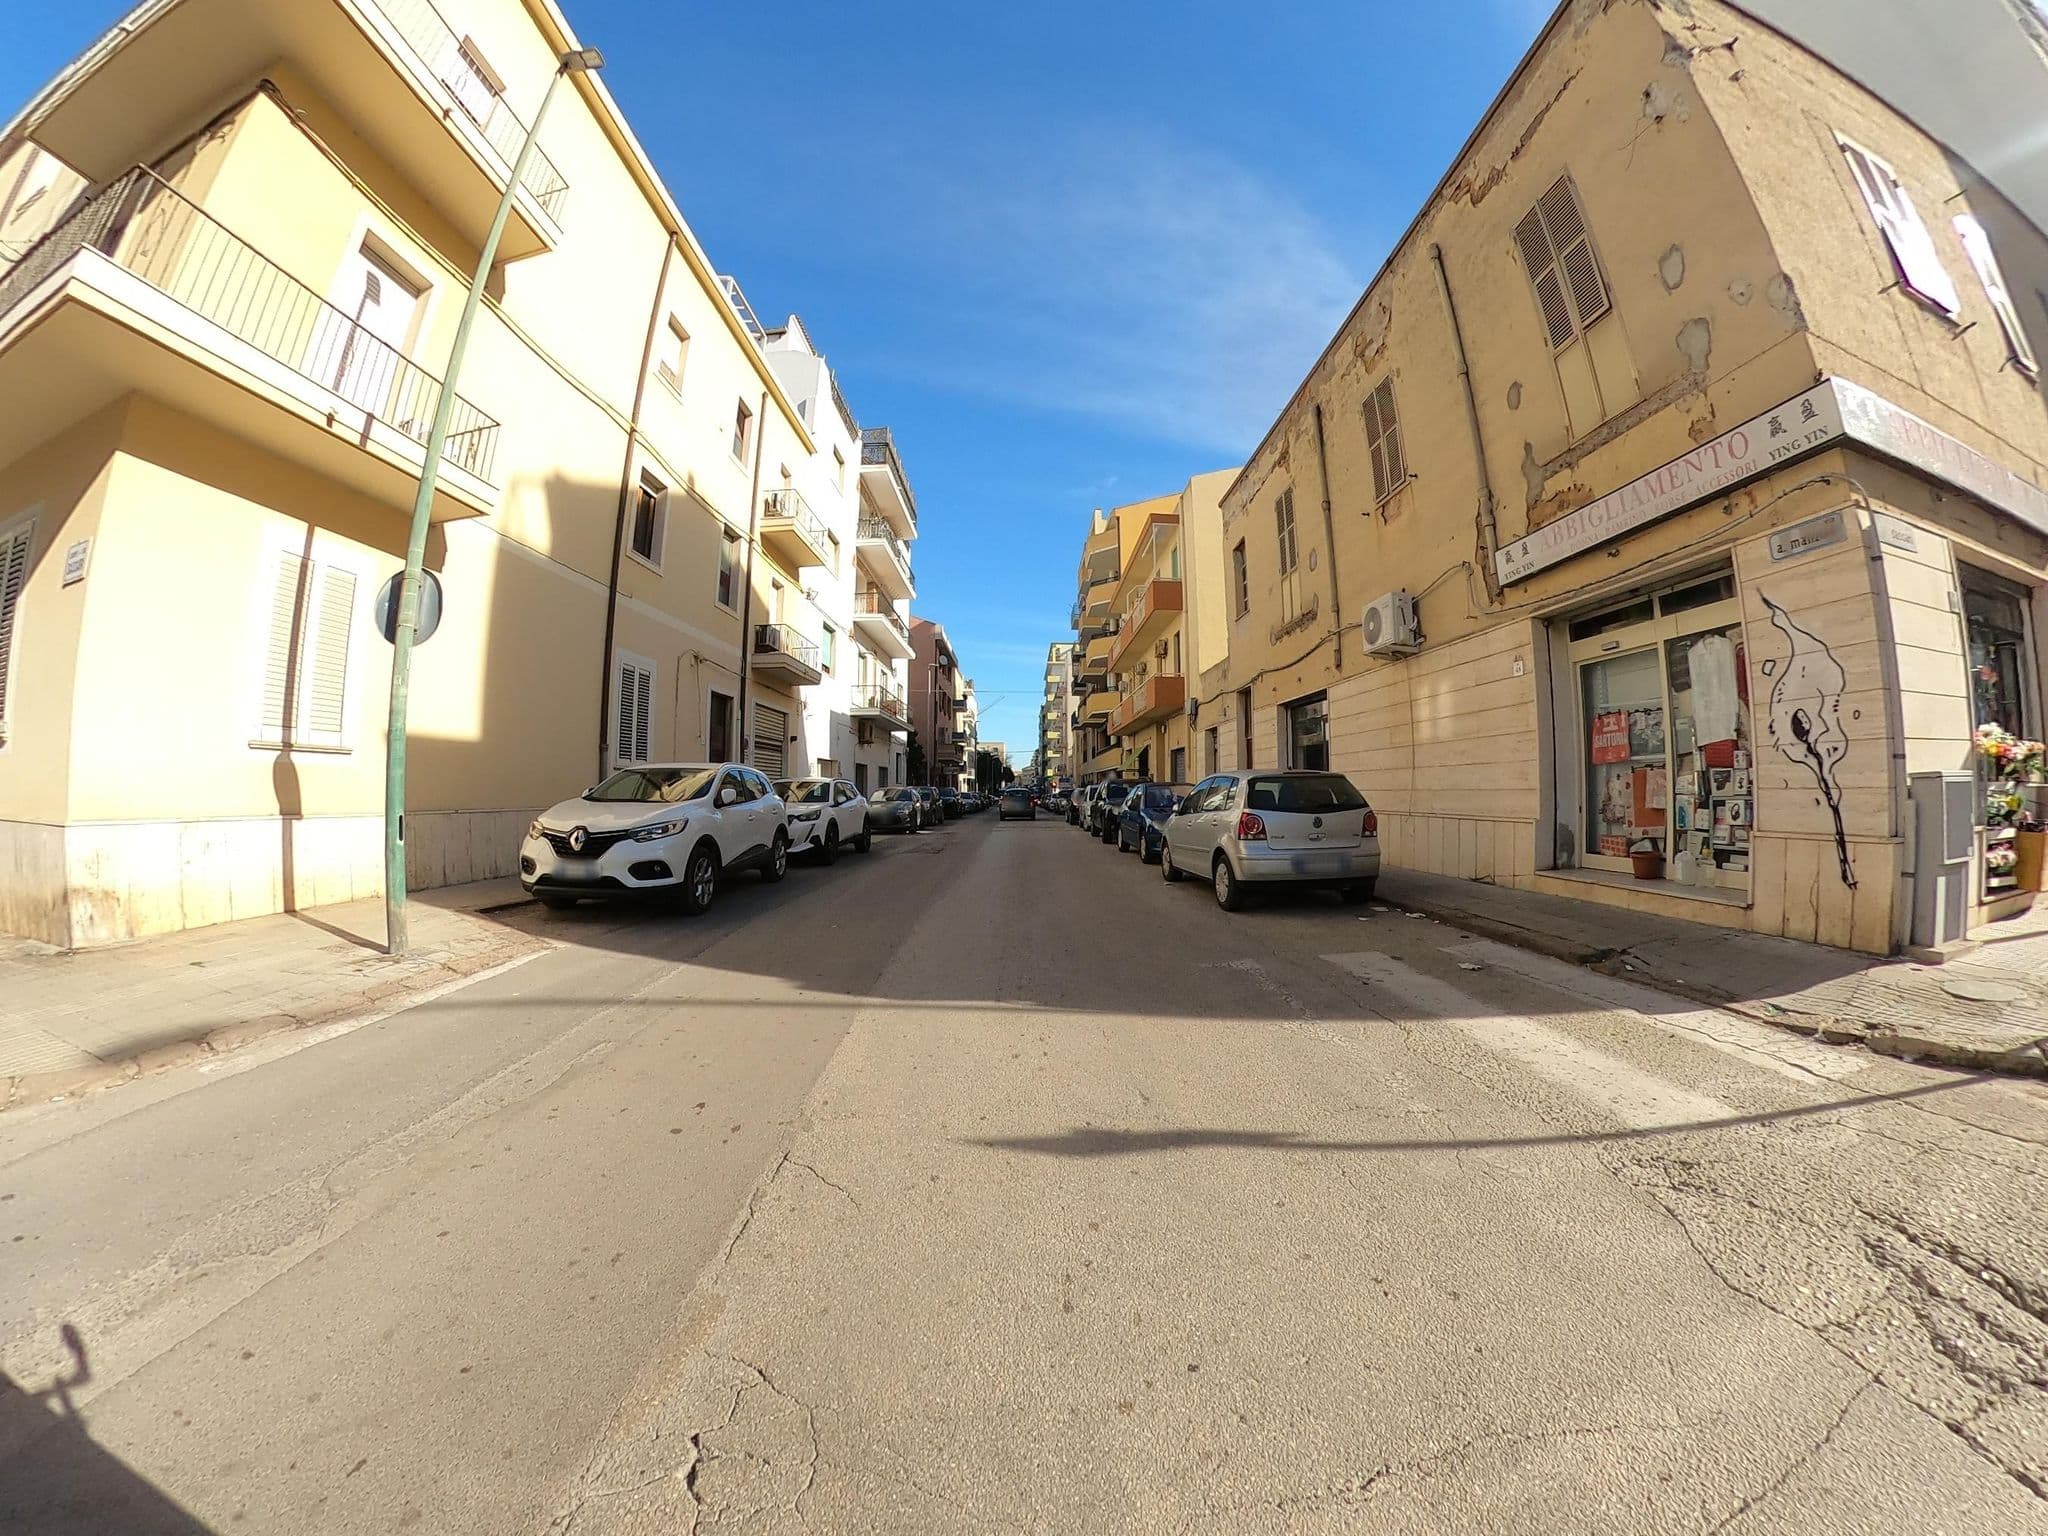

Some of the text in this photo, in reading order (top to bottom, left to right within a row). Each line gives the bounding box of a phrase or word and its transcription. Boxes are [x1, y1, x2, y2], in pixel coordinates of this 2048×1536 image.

[1768, 425, 1829, 461] YING YIN
[1539, 431, 1750, 553] ABBIGLIAMENTO
[1696, 460, 1758, 495] ACCESSORI
